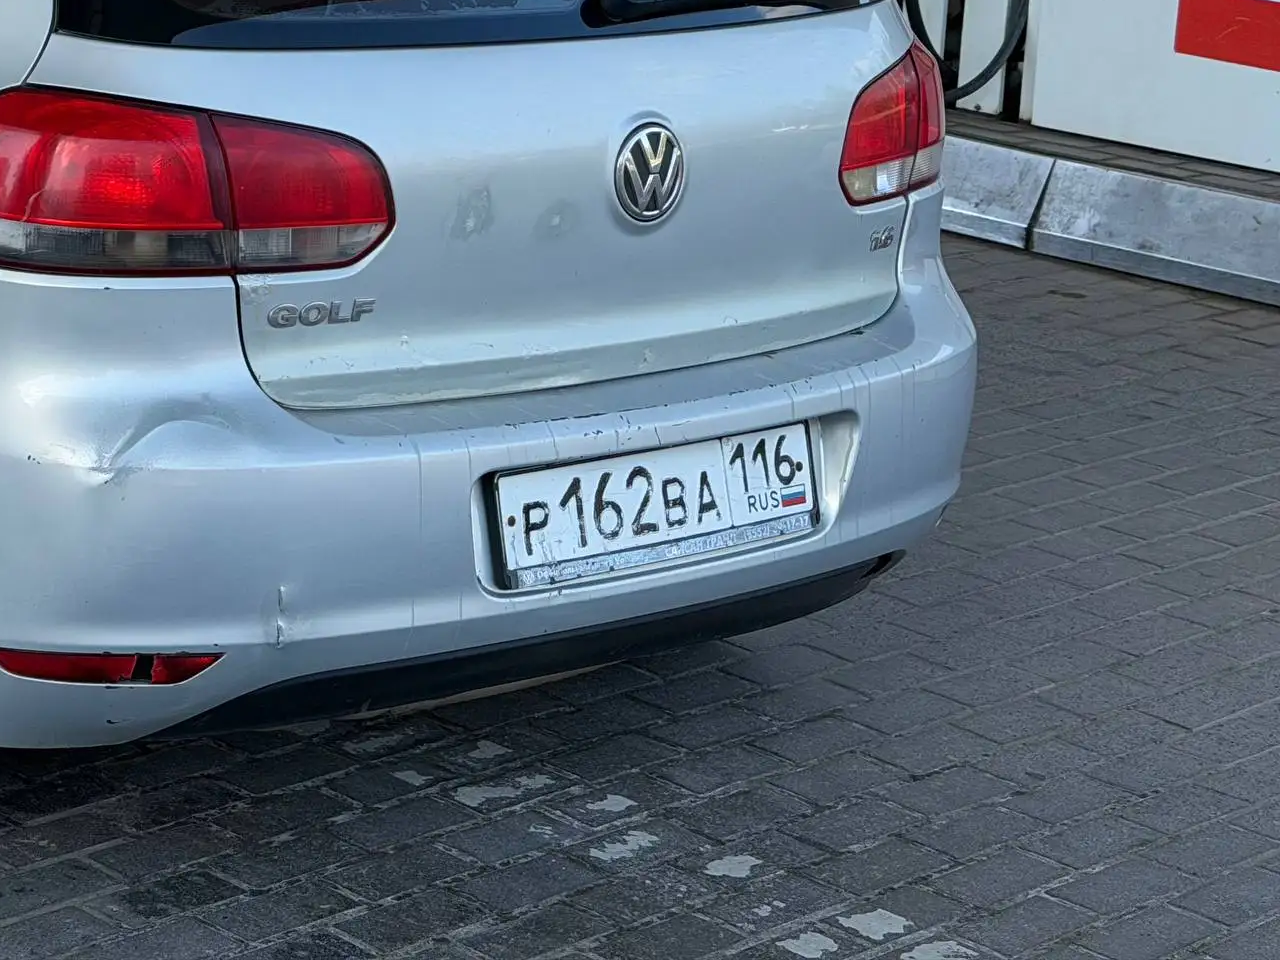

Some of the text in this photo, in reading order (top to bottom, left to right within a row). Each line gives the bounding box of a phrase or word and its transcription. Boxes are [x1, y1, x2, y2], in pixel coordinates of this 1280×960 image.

[267, 298, 377, 329] GOLF
[729, 434, 796, 494] 116
[748, 489, 781, 514] RUS
